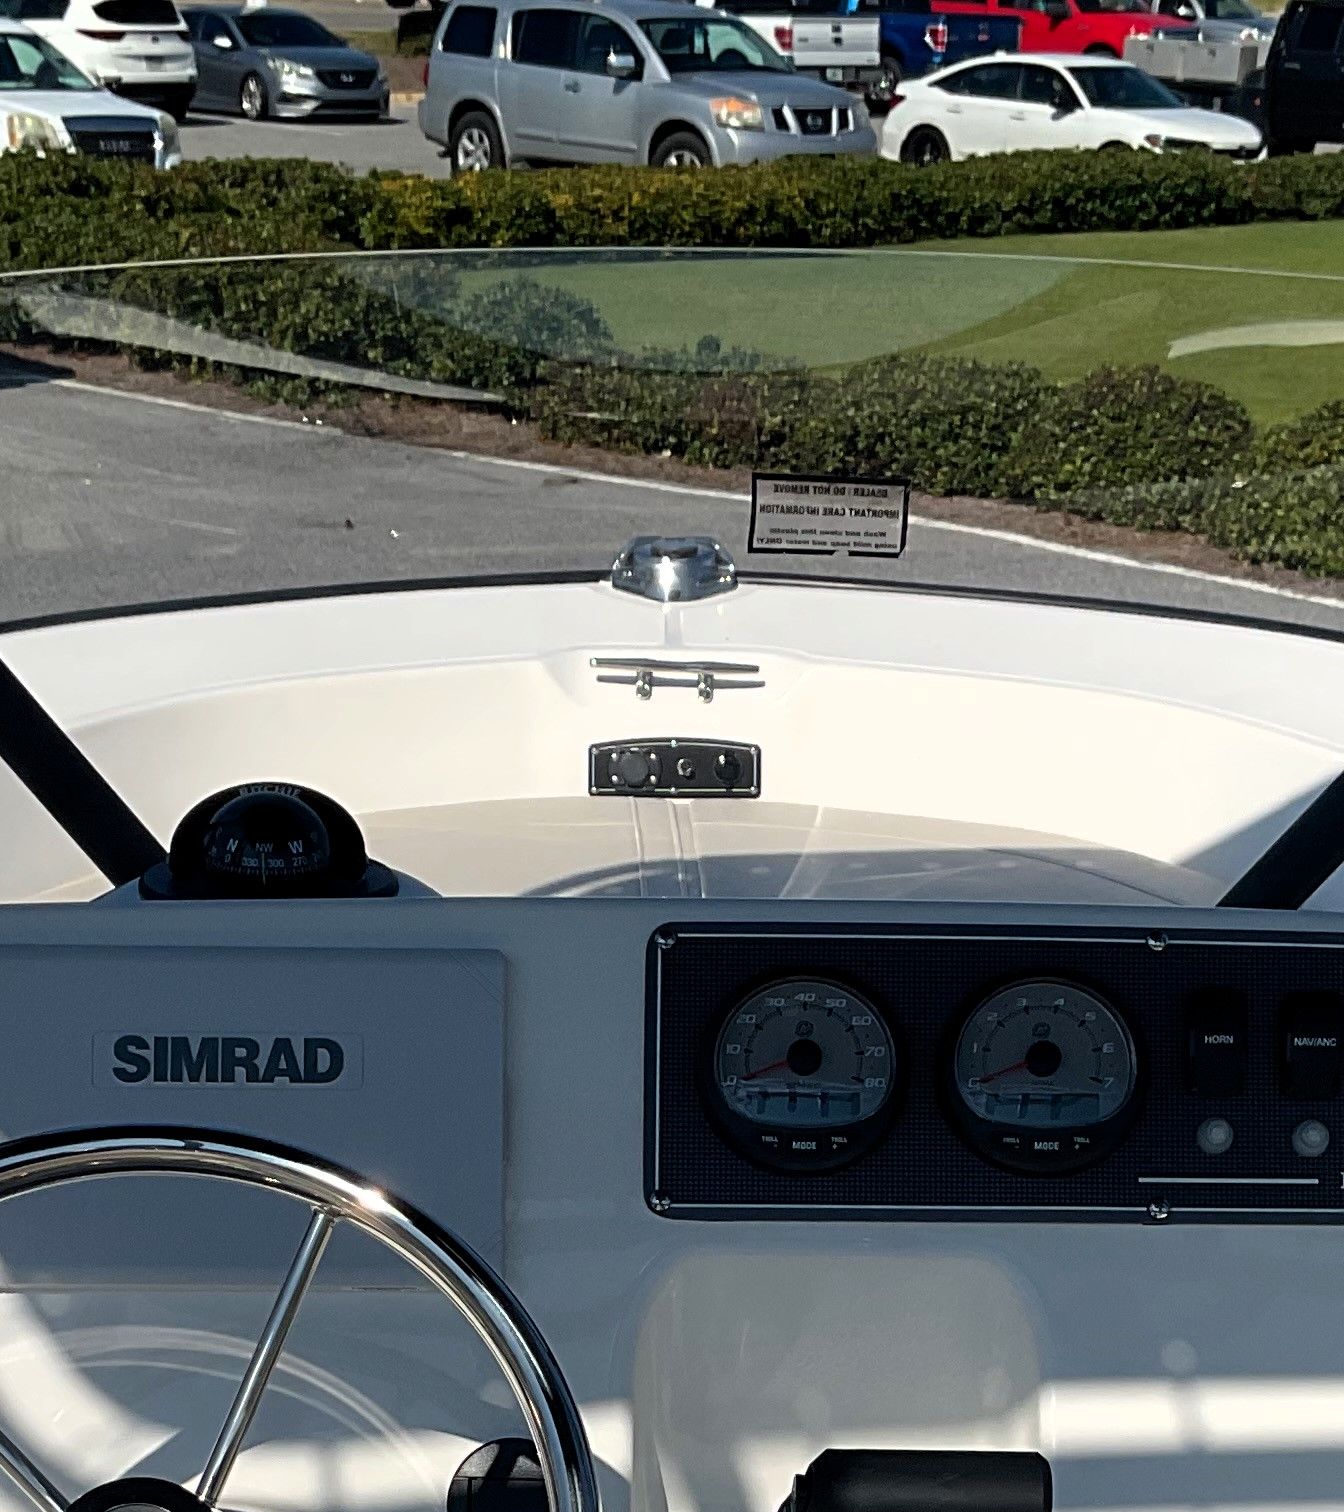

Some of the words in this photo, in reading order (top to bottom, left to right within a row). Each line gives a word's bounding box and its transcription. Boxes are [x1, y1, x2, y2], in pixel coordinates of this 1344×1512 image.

[227, 838, 238, 852] N
[256, 843, 273, 853] NW
[288, 840, 303, 853] W
[794, 993, 816, 1002] 40
[1016, 998, 1027, 1007] 3
[1054, 998, 1065, 1006] 4
[825, 999, 846, 1008] 50
[1085, 1011, 1096, 1021] 5
[1205, 1034, 1234, 1044] HORN
[1293, 1037, 1337, 1047] NAV/ANC
[726, 1044, 741, 1054] 10
[864, 1047, 885, 1057] 70
[973, 1042, 978, 1053] 1
[1102, 1042, 1115, 1053] 6
[111, 1034, 345, 1084] SIMRAD
[1105, 1077, 1114, 1088] 7
[792, 1141, 816, 1150] MODE
[1033, 1142, 1060, 1150] MODE
